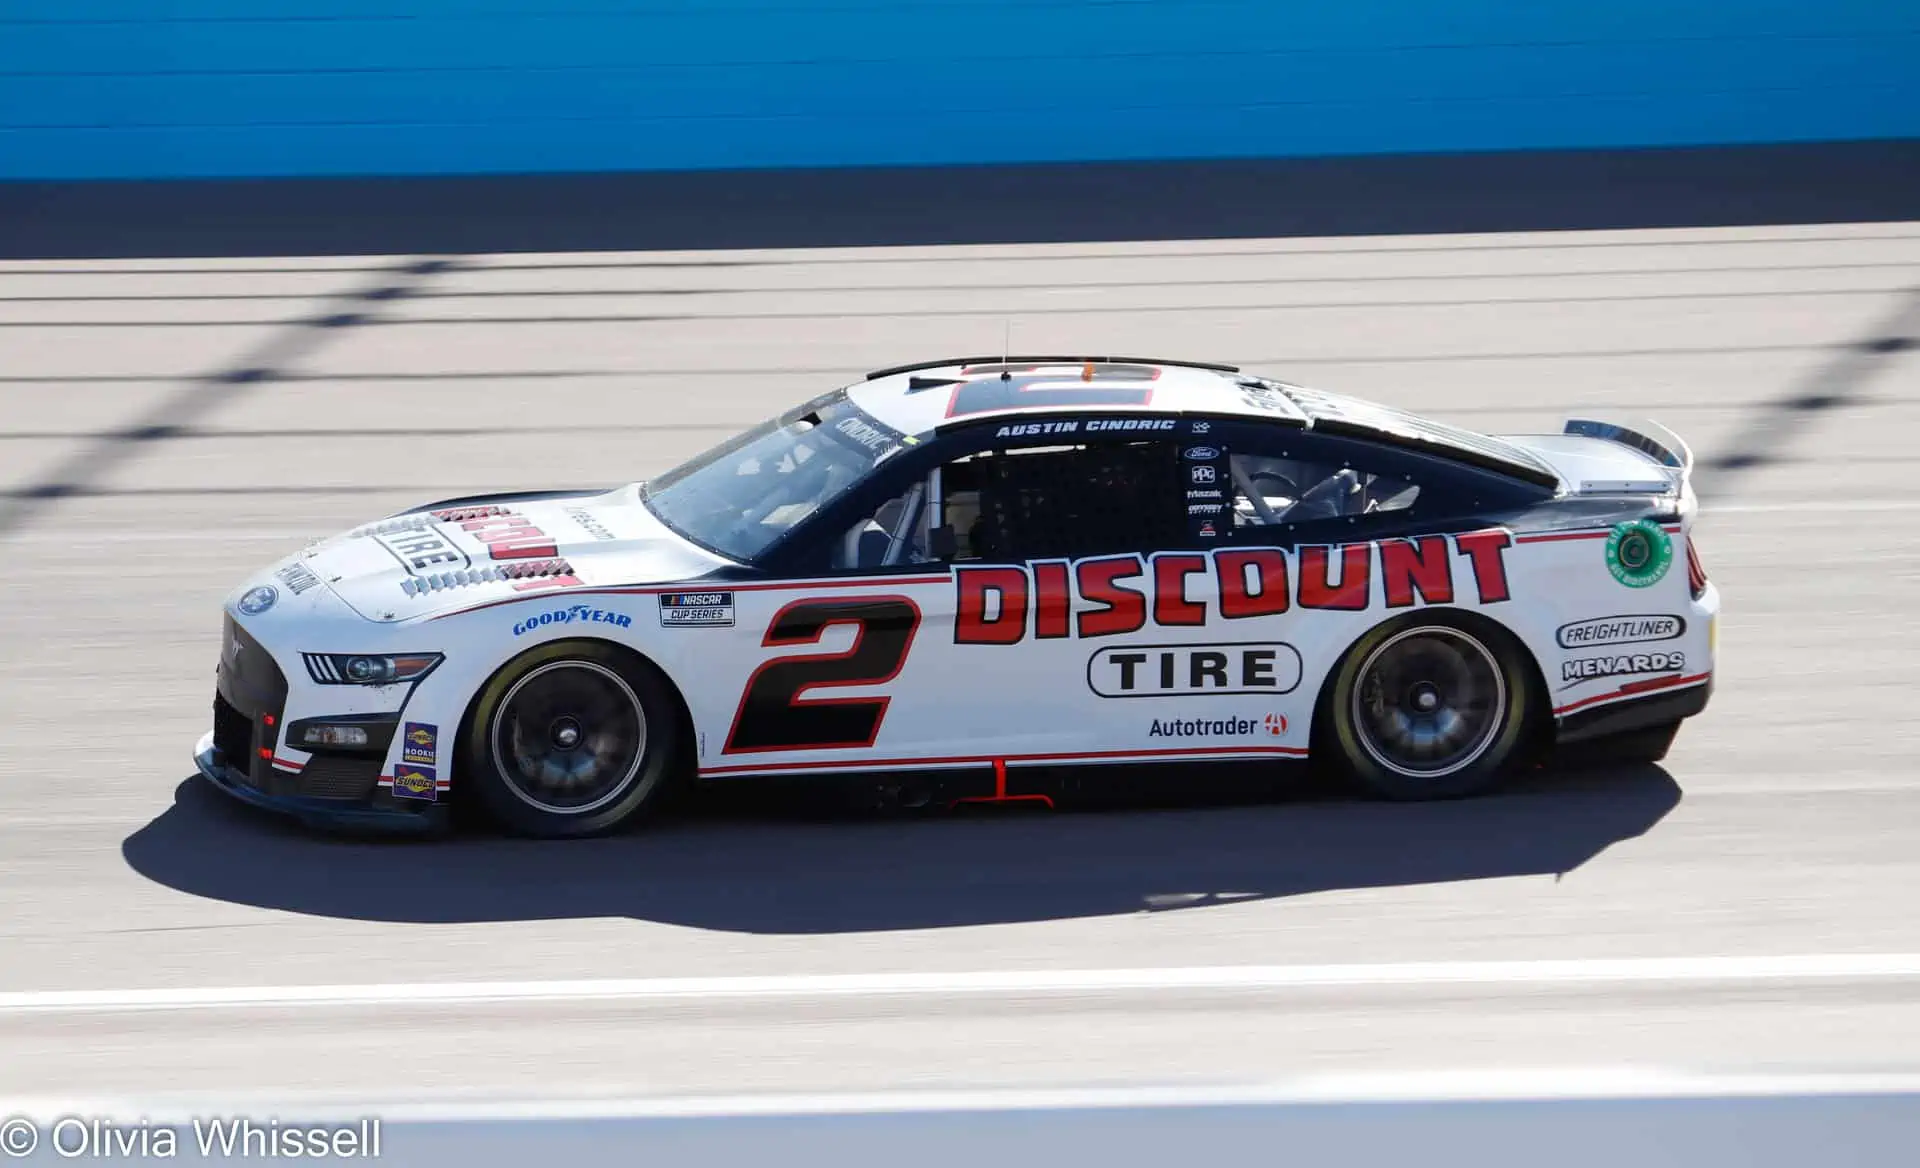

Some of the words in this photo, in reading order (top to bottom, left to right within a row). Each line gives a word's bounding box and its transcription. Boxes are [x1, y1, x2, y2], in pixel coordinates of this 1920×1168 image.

[995, 421, 1079, 438] AUSTIN
[1084, 419, 1177, 432] CINDRIC
[1191, 447, 1213, 458] Ford
[1193, 467, 1214, 481] PPG
[381, 525, 459, 569] TIRE
[952, 528, 1512, 646] DISCOUNT
[682, 593, 723, 605] NASCAR
[512, 605, 632, 636] GOODYEAR
[671, 609, 690, 620] CUP
[690, 608, 724, 619] SERIES
[1565, 620, 1675, 643] FREIGHTLINER
[721, 594, 922, 756] 2
[1109, 650, 1278, 690] TIRE
[1561, 651, 1686, 681] MENARDS
[1149, 715, 1259, 737] Autotrader
